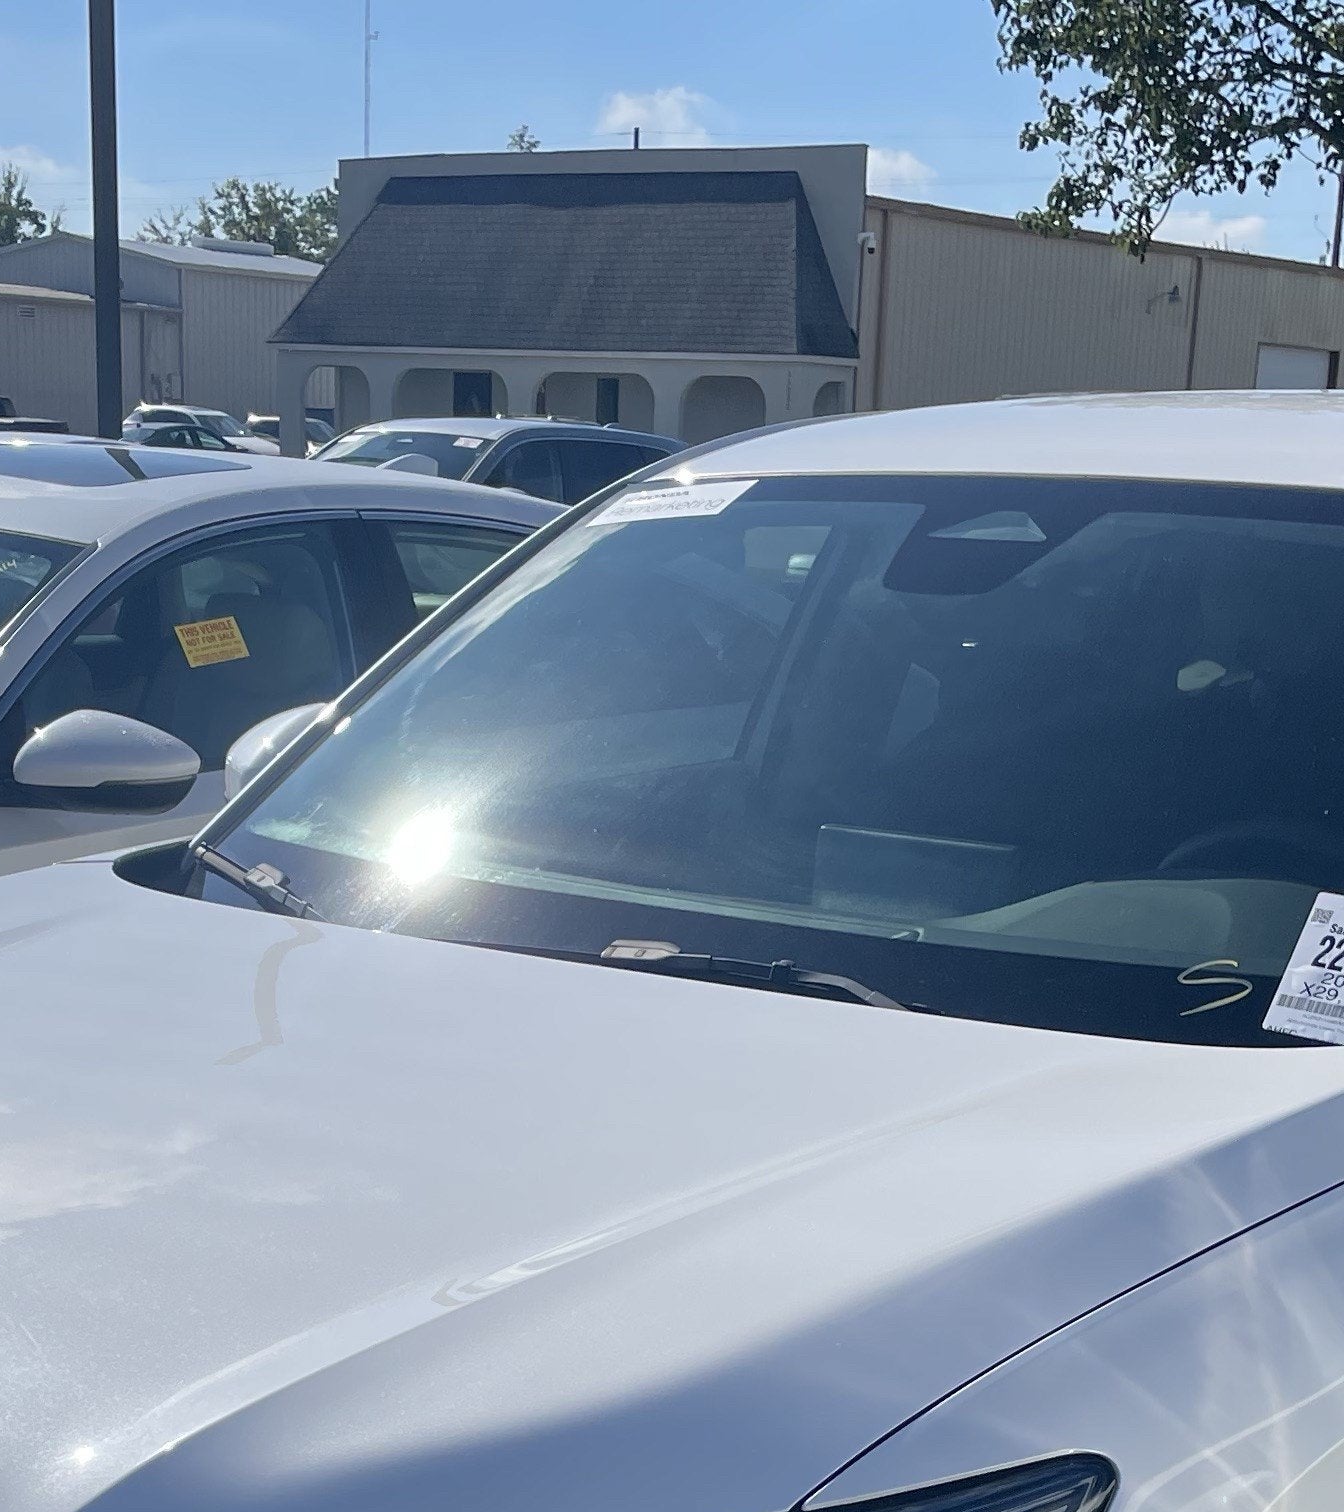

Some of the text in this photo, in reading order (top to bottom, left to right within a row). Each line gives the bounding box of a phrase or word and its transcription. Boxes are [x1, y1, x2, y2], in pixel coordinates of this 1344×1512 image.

[179, 619, 234, 638] THIS VEHICLE
[185, 637, 200, 647] NOT
[202, 634, 217, 644] FOR
[216, 630, 237, 642] SALE
